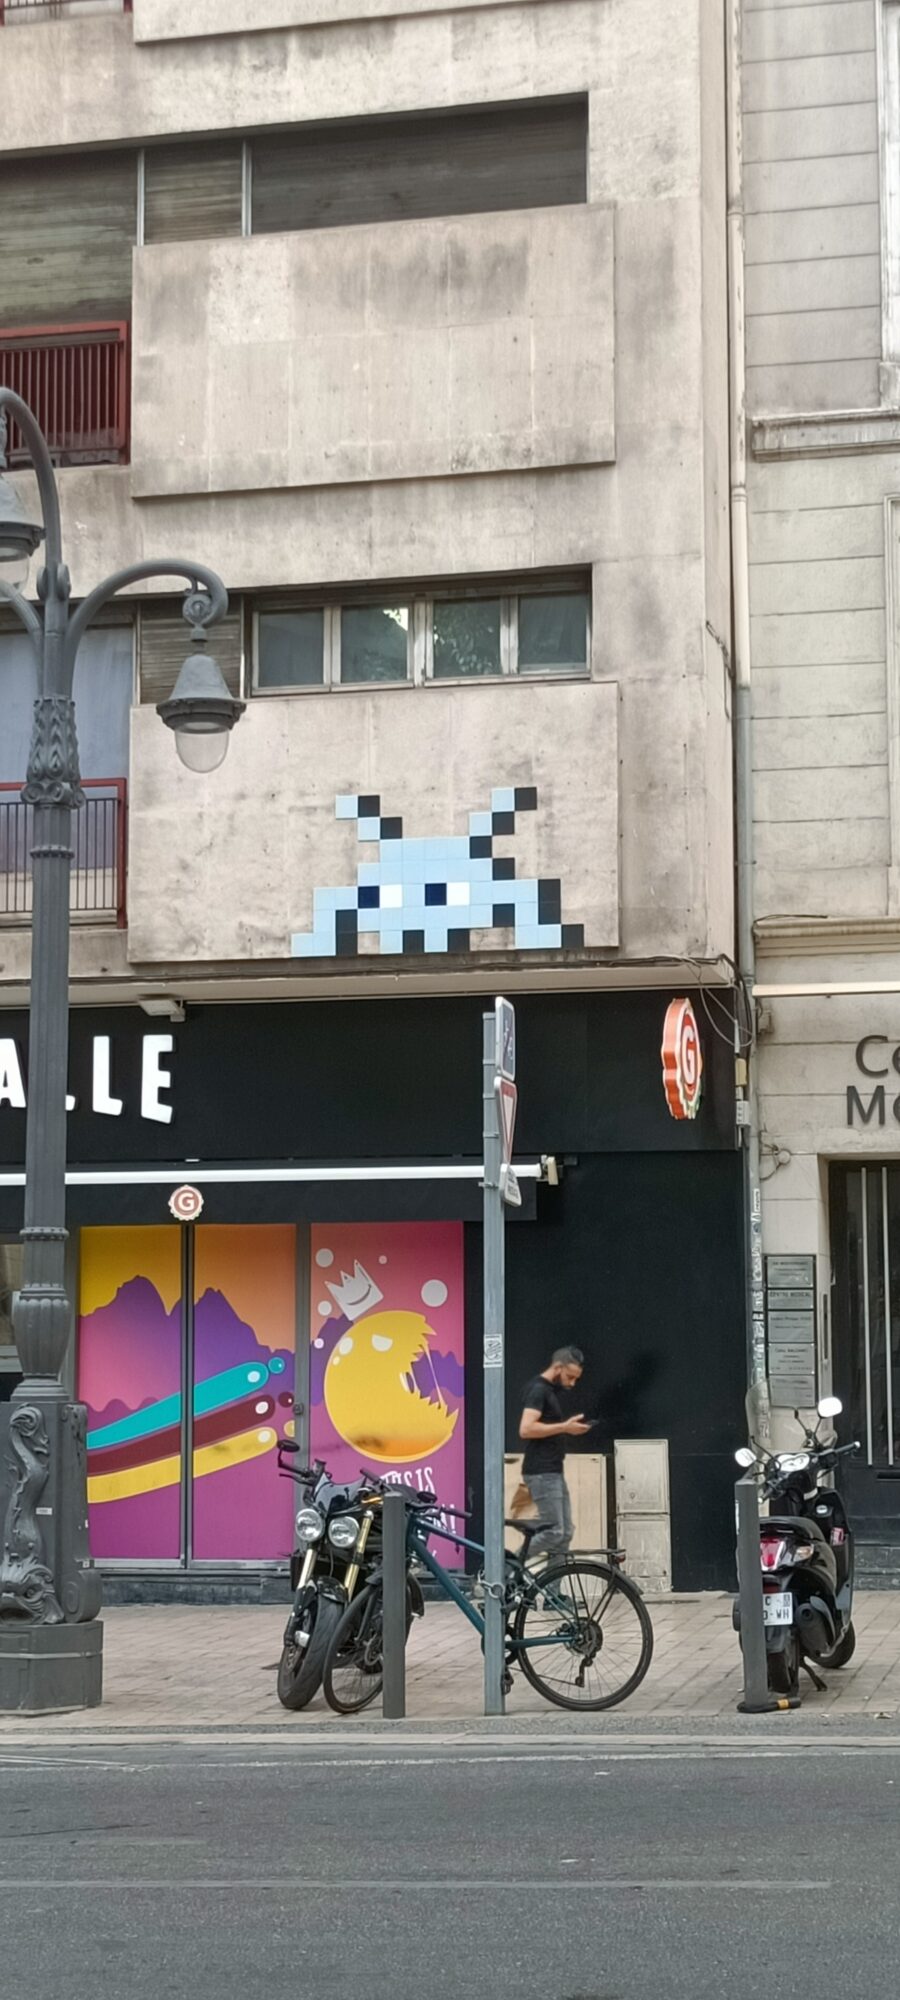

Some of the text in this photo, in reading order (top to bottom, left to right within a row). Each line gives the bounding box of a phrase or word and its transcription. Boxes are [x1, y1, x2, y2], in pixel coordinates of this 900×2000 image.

[681, 1024, 696, 1085] G
[0, 1034, 173, 1124] ALE
[178, 1194, 196, 1212] G
[415, 1467, 436, 1494] IS
